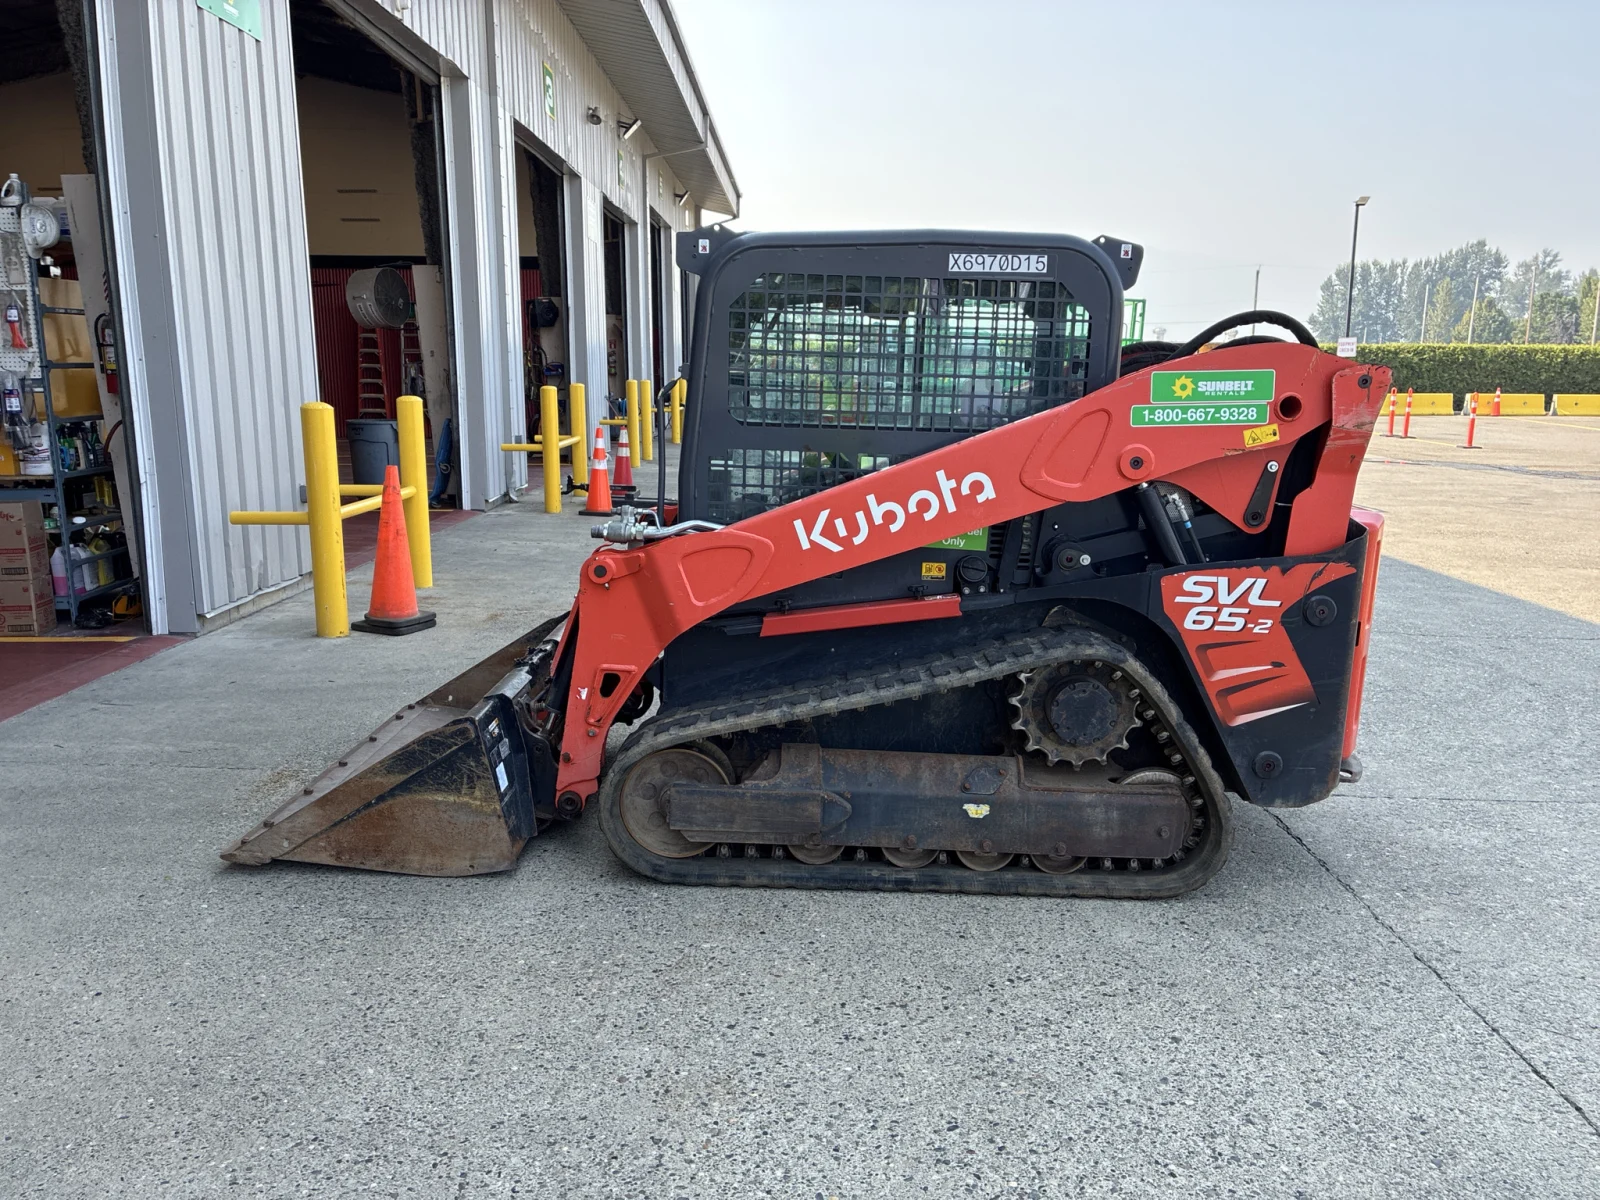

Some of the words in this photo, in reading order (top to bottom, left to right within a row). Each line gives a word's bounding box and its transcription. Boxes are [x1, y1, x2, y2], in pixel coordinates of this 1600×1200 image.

[545, 75, 553, 108] 3
[950, 254, 1046, 272] X6970D15
[1197, 380, 1254, 392] SUNBELT
[1142, 407, 1257, 422] 1-800-667-9328
[793, 469, 996, 553] Kubota
[942, 537, 965, 547] Only
[1174, 575, 1283, 607] SVL
[1183, 606, 1274, 634] 65-2
